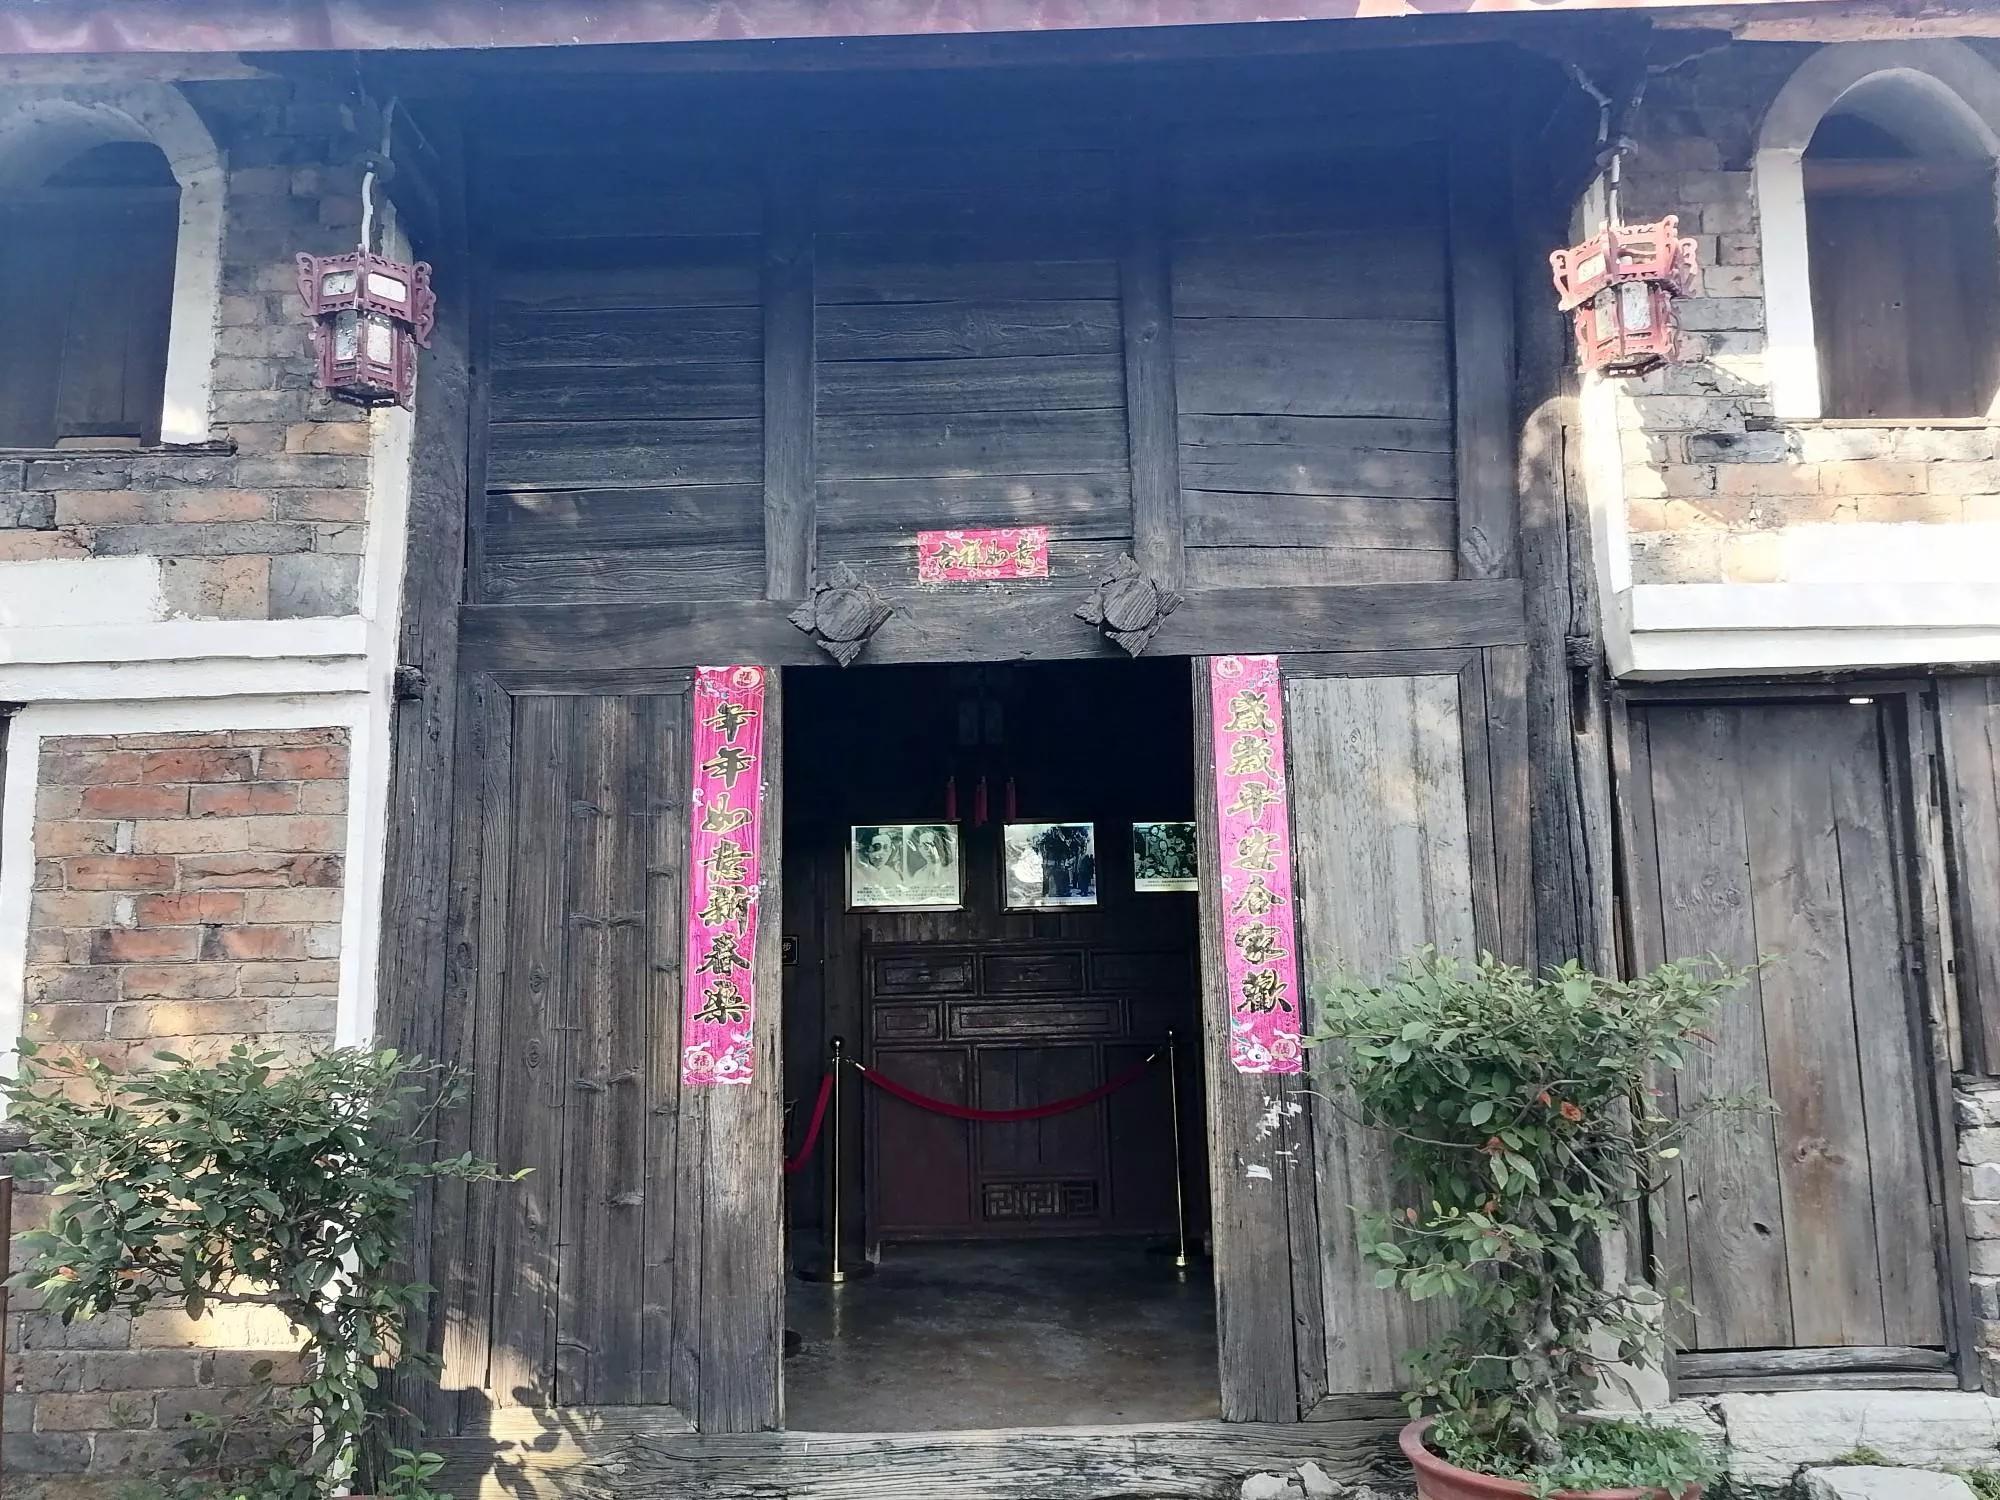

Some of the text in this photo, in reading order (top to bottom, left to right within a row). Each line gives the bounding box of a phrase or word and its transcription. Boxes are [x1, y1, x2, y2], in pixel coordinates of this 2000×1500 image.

[932, 538, 1036, 569] 吉祥如意
[693, 1053, 710, 1069] 福
